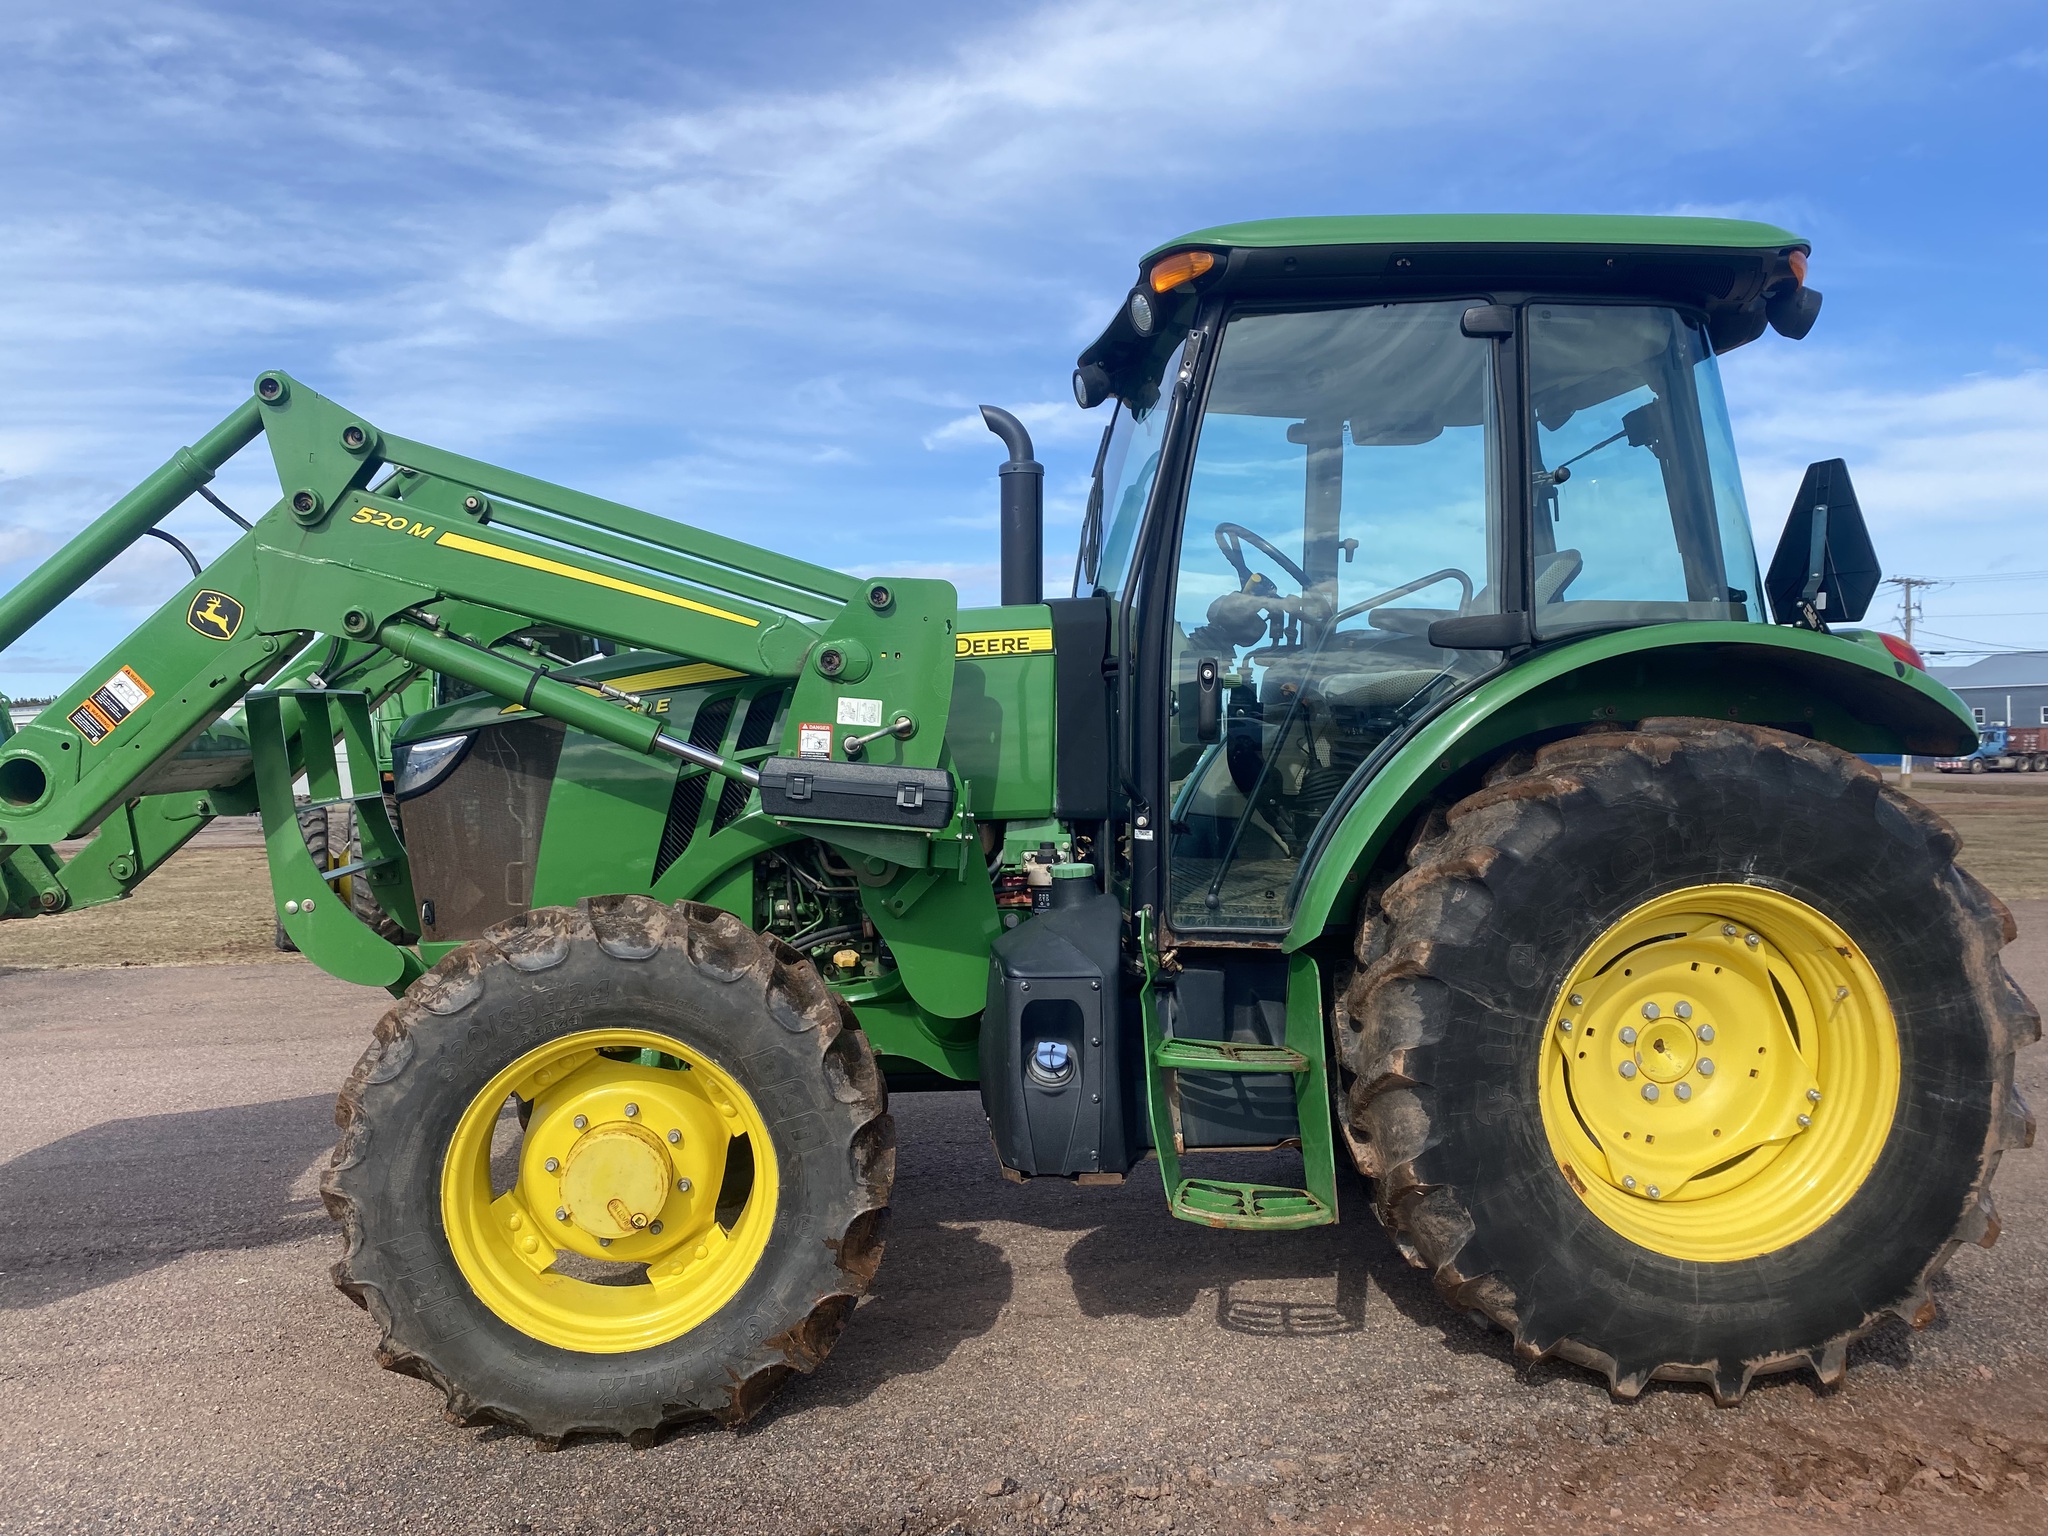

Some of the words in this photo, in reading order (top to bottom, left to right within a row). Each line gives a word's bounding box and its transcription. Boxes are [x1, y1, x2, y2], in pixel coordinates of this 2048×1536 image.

[350, 506, 409, 531] 520
[406, 522, 436, 539] M
[955, 637, 1030, 654] DEERE
[91, 708, 110, 728] WARNING
